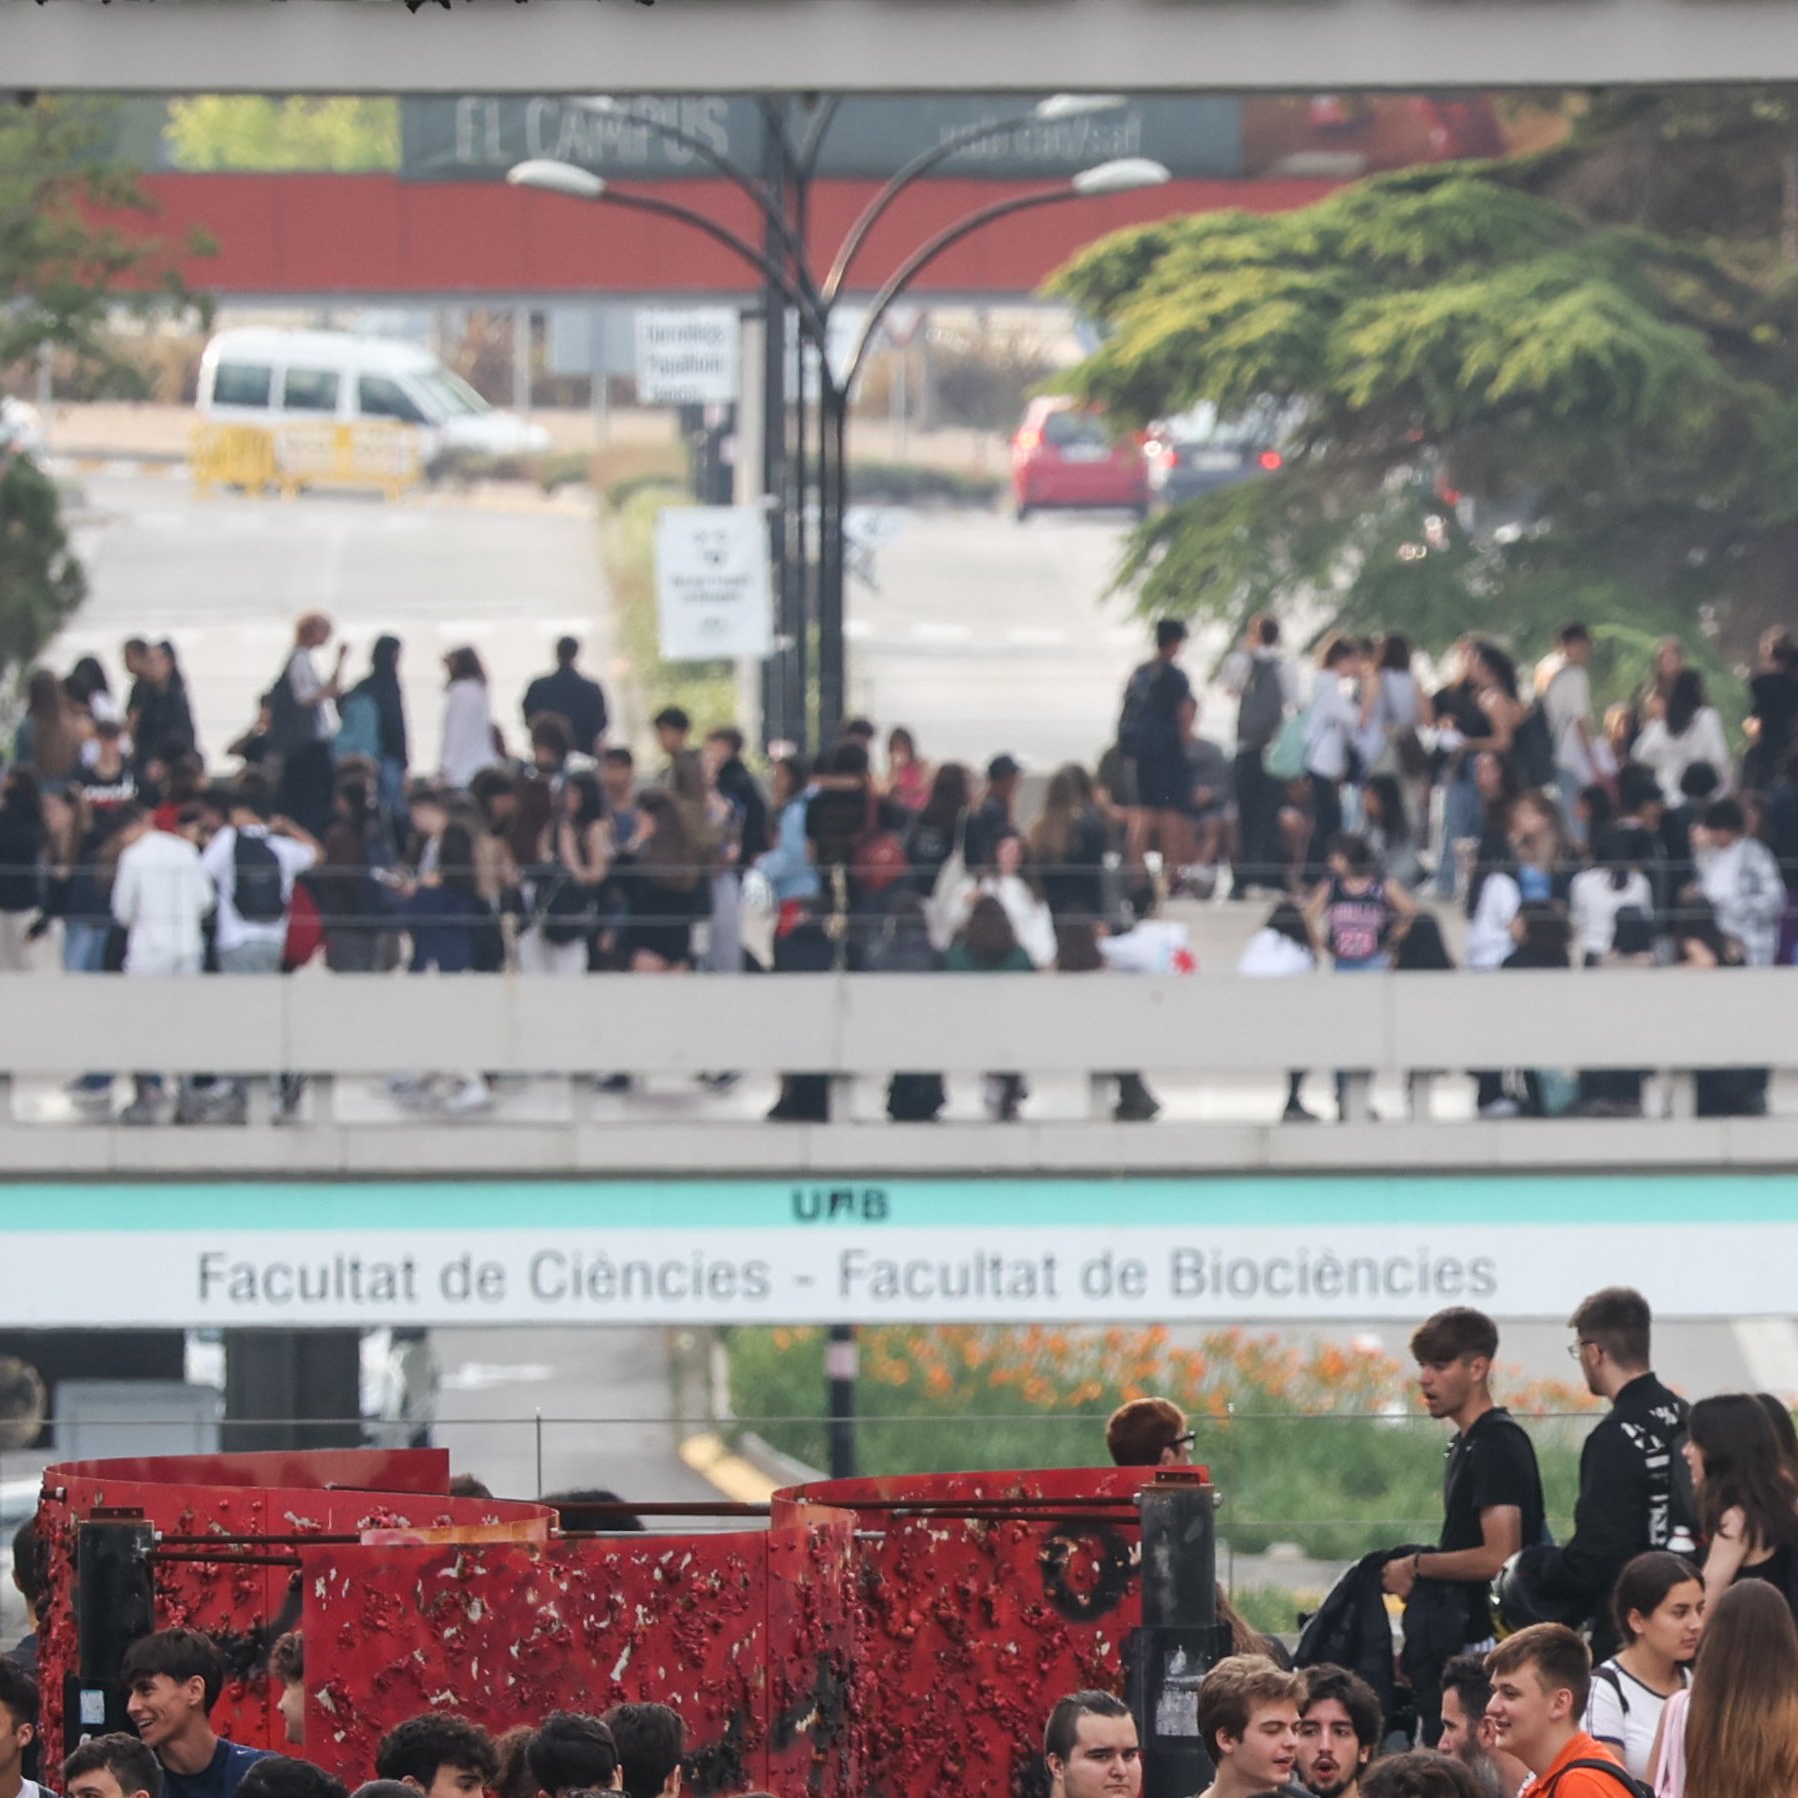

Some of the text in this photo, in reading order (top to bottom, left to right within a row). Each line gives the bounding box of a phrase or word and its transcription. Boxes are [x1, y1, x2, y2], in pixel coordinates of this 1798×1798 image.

[198, 1250, 419, 1304] Facultat
[439, 1250, 507, 1304] de
[528, 1249, 772, 1304] Ciències
[838, 1247, 1059, 1301] Facultat
[1078, 1247, 1149, 1300] de
[1169, 1245, 1499, 1300] Biociències
